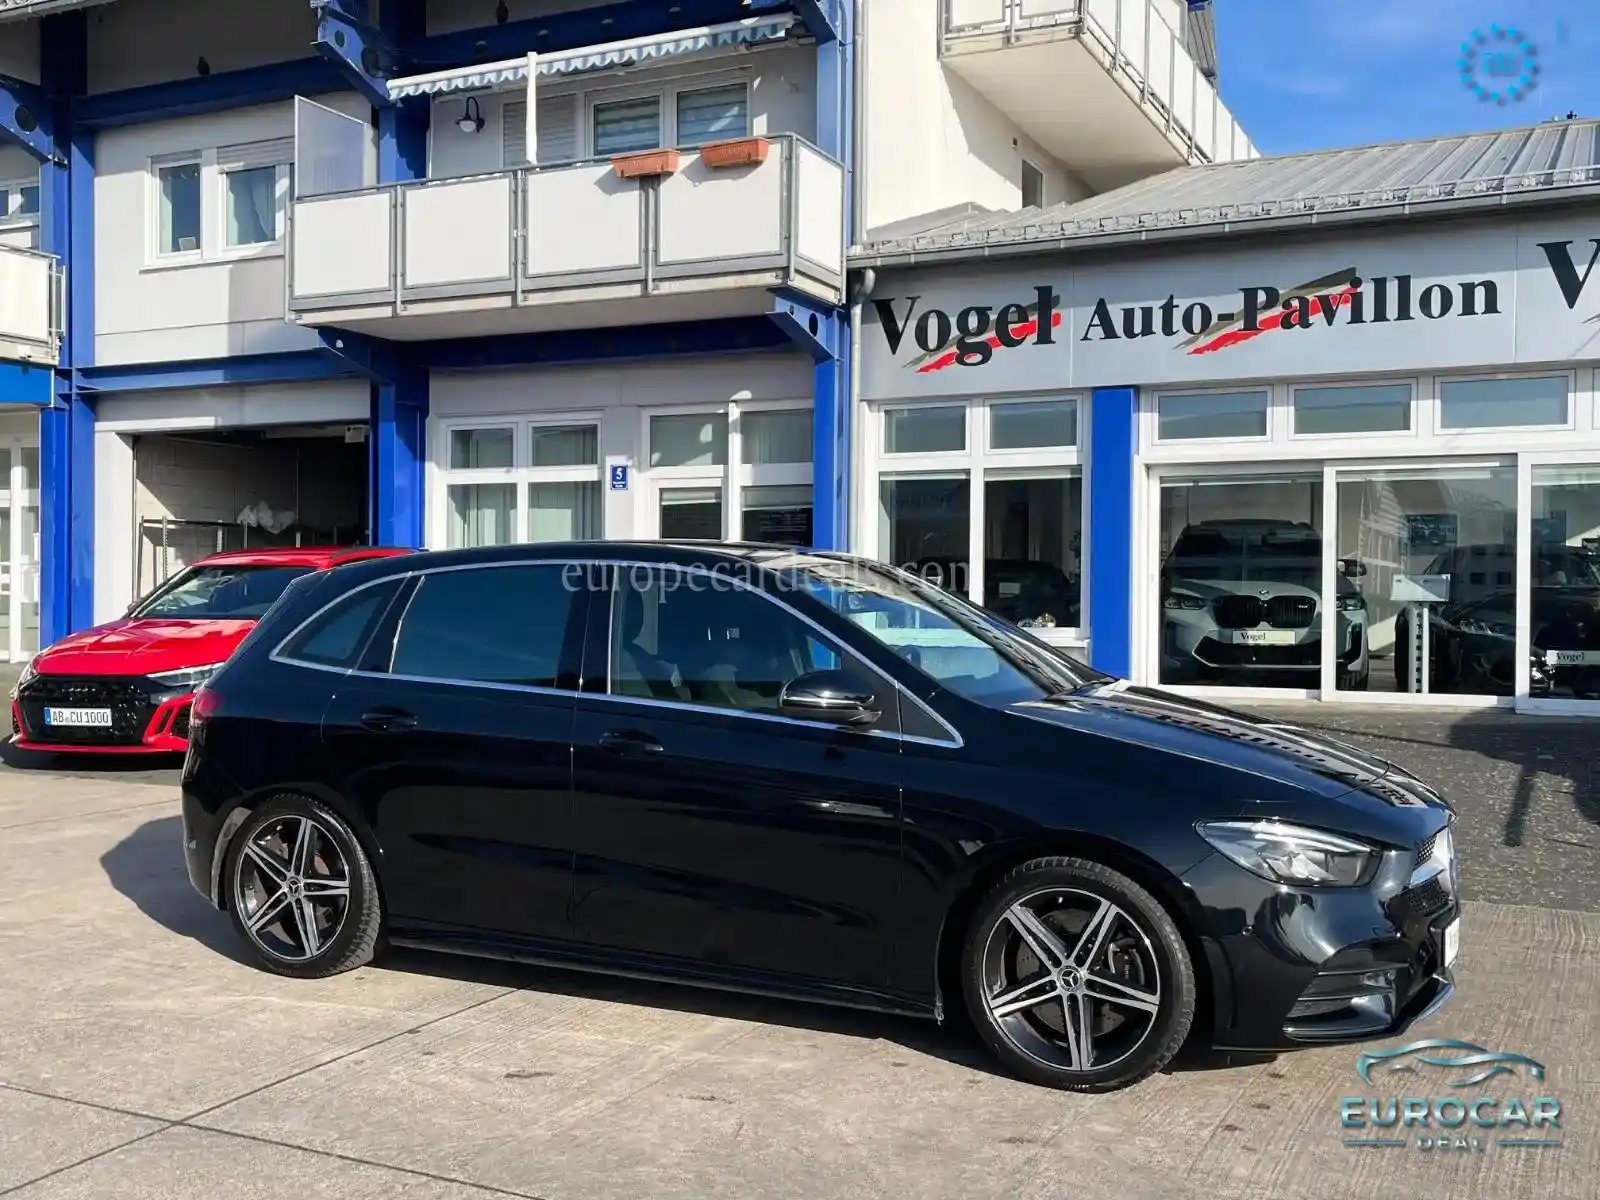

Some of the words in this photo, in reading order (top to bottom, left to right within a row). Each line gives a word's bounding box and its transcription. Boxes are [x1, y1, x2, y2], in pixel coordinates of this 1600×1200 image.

[869, 285, 1057, 367] Vogel
[1080, 274, 1502, 341] Auto-Pavillon
[616, 467, 623, 480] 5
[1240, 632, 1266, 641] Vogel
[1557, 652, 1585, 662] Vogel
[53, 712, 64, 723] AB
[84, 712, 109, 724] 1000
